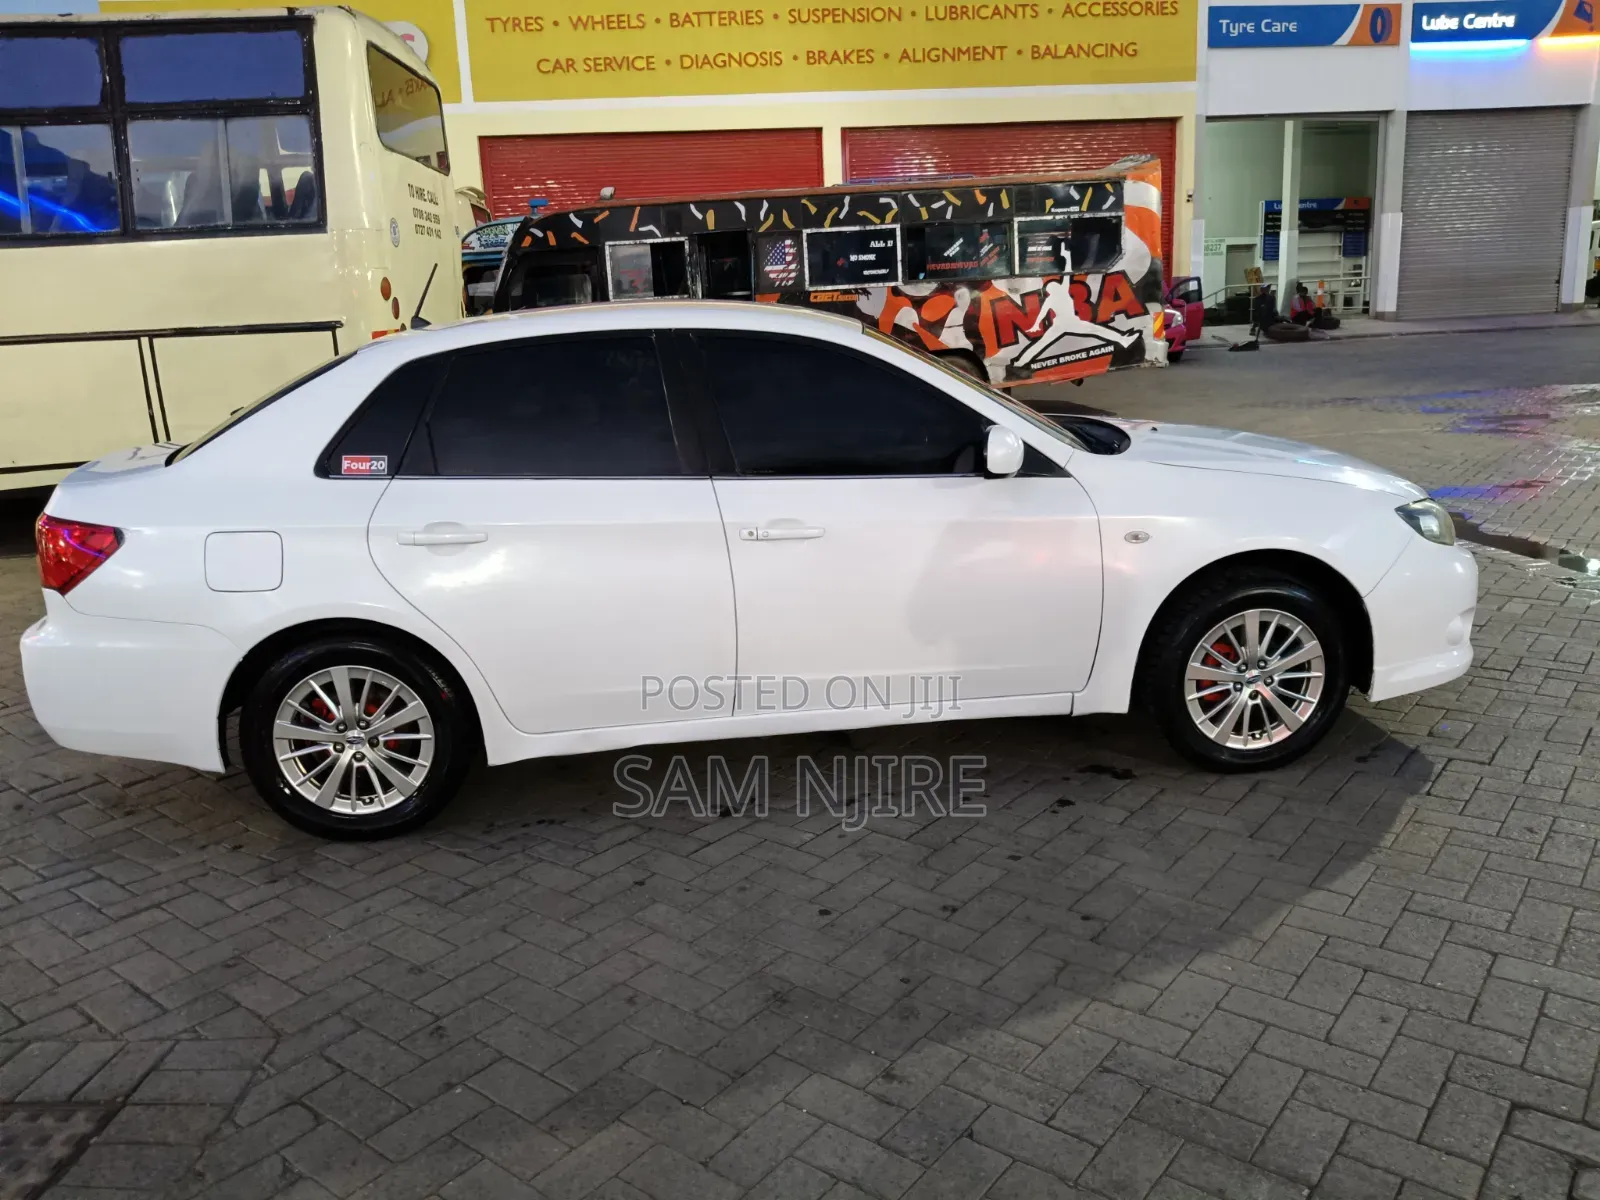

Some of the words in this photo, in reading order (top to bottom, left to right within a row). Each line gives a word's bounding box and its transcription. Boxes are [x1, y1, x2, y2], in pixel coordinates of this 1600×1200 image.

[486, 16, 544, 33] TYRES
[568, 13, 646, 31] WHEELS
[669, 9, 764, 28] BATTERIES
[788, 6, 902, 24] SUSPENSION
[925, 3, 1039, 21] LUBRICANTS
[1061, 0, 1179, 18] ACCESSORIES
[1218, 19, 1255, 36] Tyre
[1261, 18, 1298, 33] Care
[1421, 14, 1460, 31] Lube
[1462, 12, 1516, 29] Centre
[536, 58, 578, 75] CAR
[583, 55, 657, 72] SERVICE
[680, 51, 783, 70] DIAGNOSIS
[806, 48, 875, 66] BRAKES
[898, 45, 1008, 63] ALIGNMENT
[1030, 42, 1138, 60] BALANCING
[408, 183, 415, 199] TO
[415, 186, 427, 202] HIRE
[427, 190, 439, 206] CALL
[1031, 358, 1058, 370] NEVER
[1059, 352, 1088, 363] BROKE
[1089, 345, 1114, 357] AGAIN
[344, 460, 386, 470] Four20
